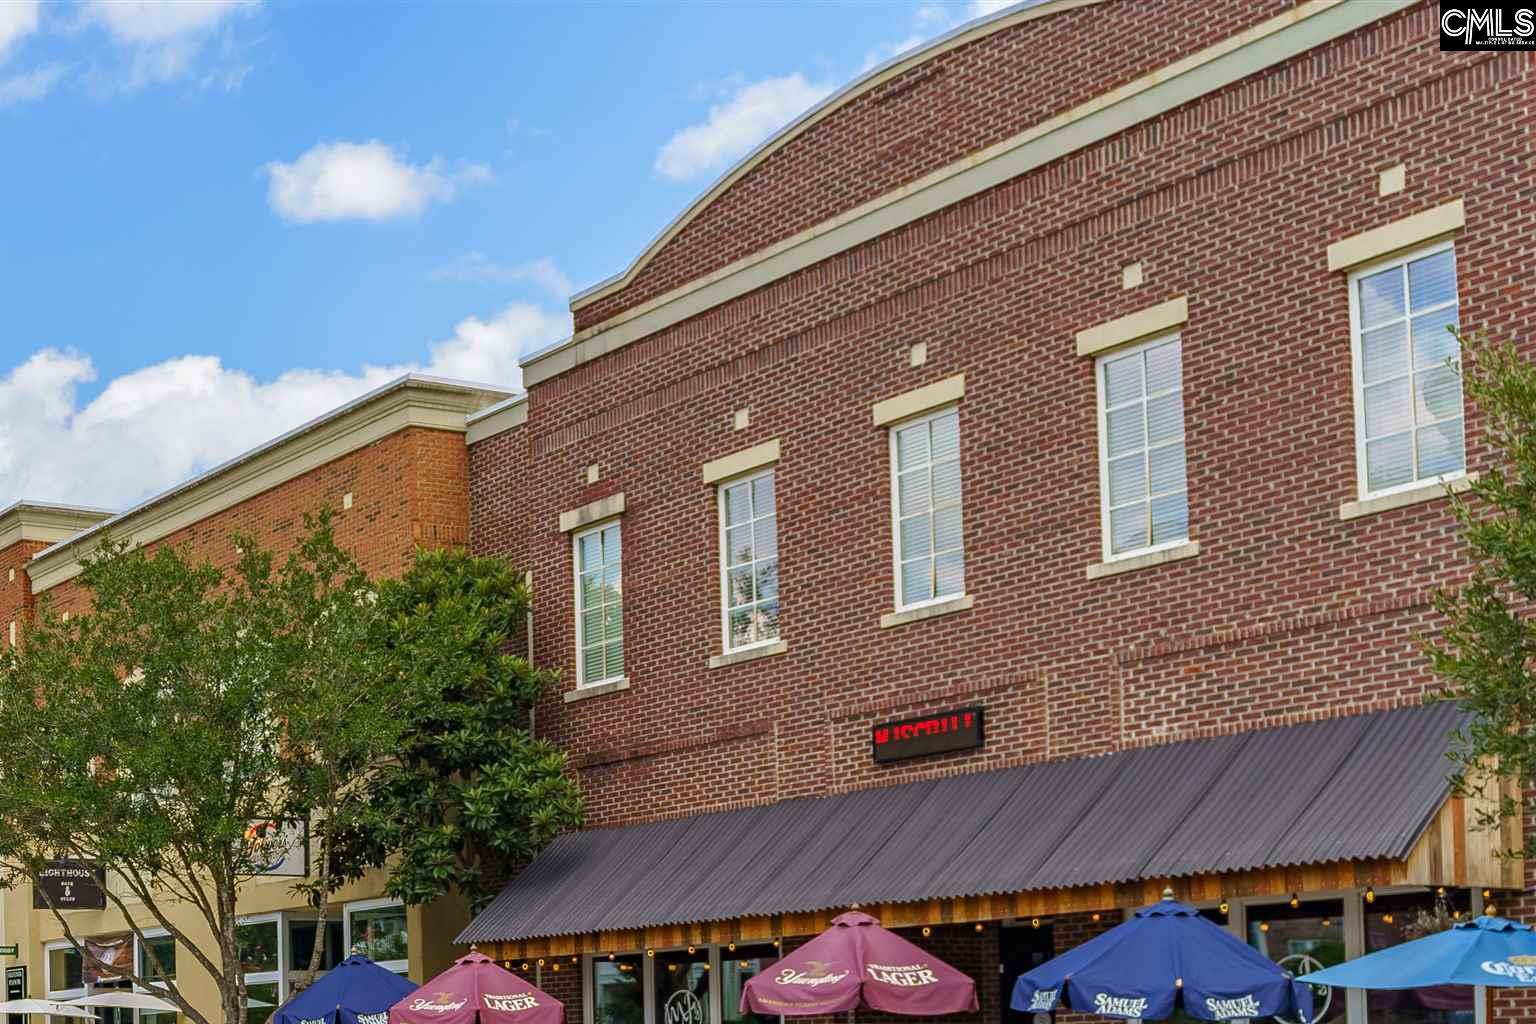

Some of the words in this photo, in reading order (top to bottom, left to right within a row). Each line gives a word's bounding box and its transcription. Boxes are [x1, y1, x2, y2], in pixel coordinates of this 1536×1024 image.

[866, 968, 939, 988] LAGER
[484, 996, 540, 1012] LAGER
[1094, 993, 1149, 1009] SAMUEL
[1205, 994, 1260, 1011] SAMUEL
[1096, 1005, 1142, 1018] ADAMS
[1214, 1006, 1259, 1020] ADAMS
